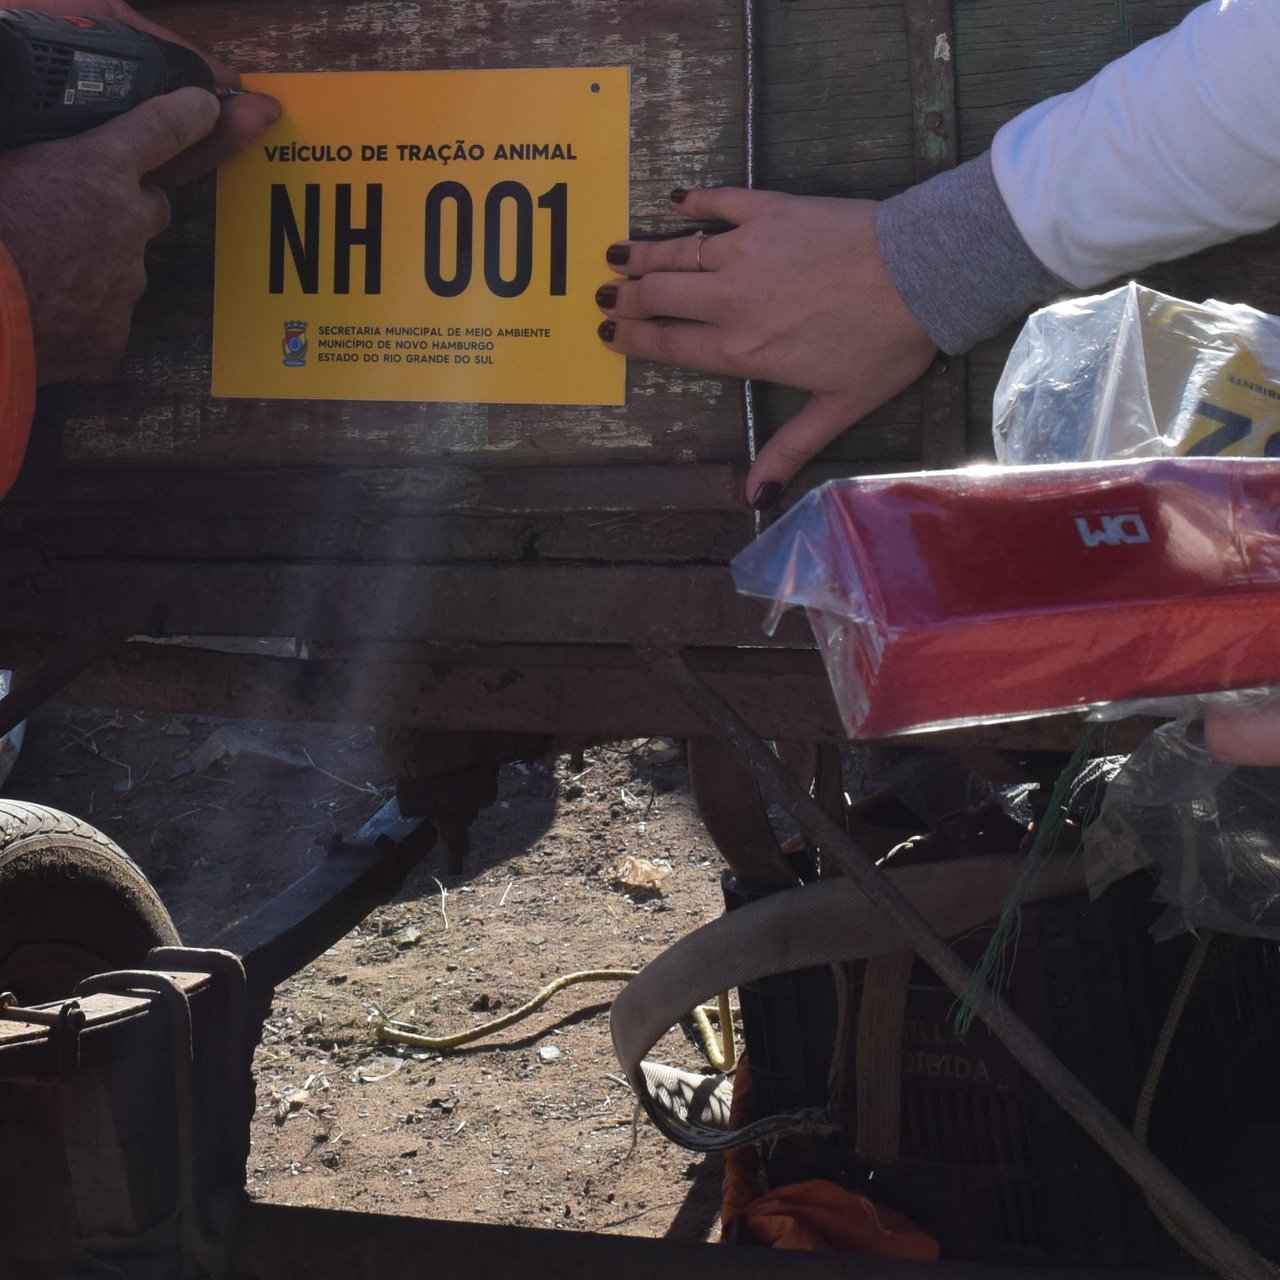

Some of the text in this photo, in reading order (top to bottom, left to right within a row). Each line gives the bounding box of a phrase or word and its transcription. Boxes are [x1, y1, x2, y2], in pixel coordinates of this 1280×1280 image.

[264, 139, 577, 166] VEÍCULO DE TRAÇÃO ANIMAL
[268, 180, 568, 298] NH 001
[318, 326, 551, 338] SECRETARIA MUNICIPAL DE MEIO AMBIENTE
[318, 338, 495, 351] MUNICÍPIO DE NOVO HAMBURGO
[318, 352, 494, 365] ESTADO DO RIO GRANDE DO SUL
[1075, 514, 1151, 547] DM
